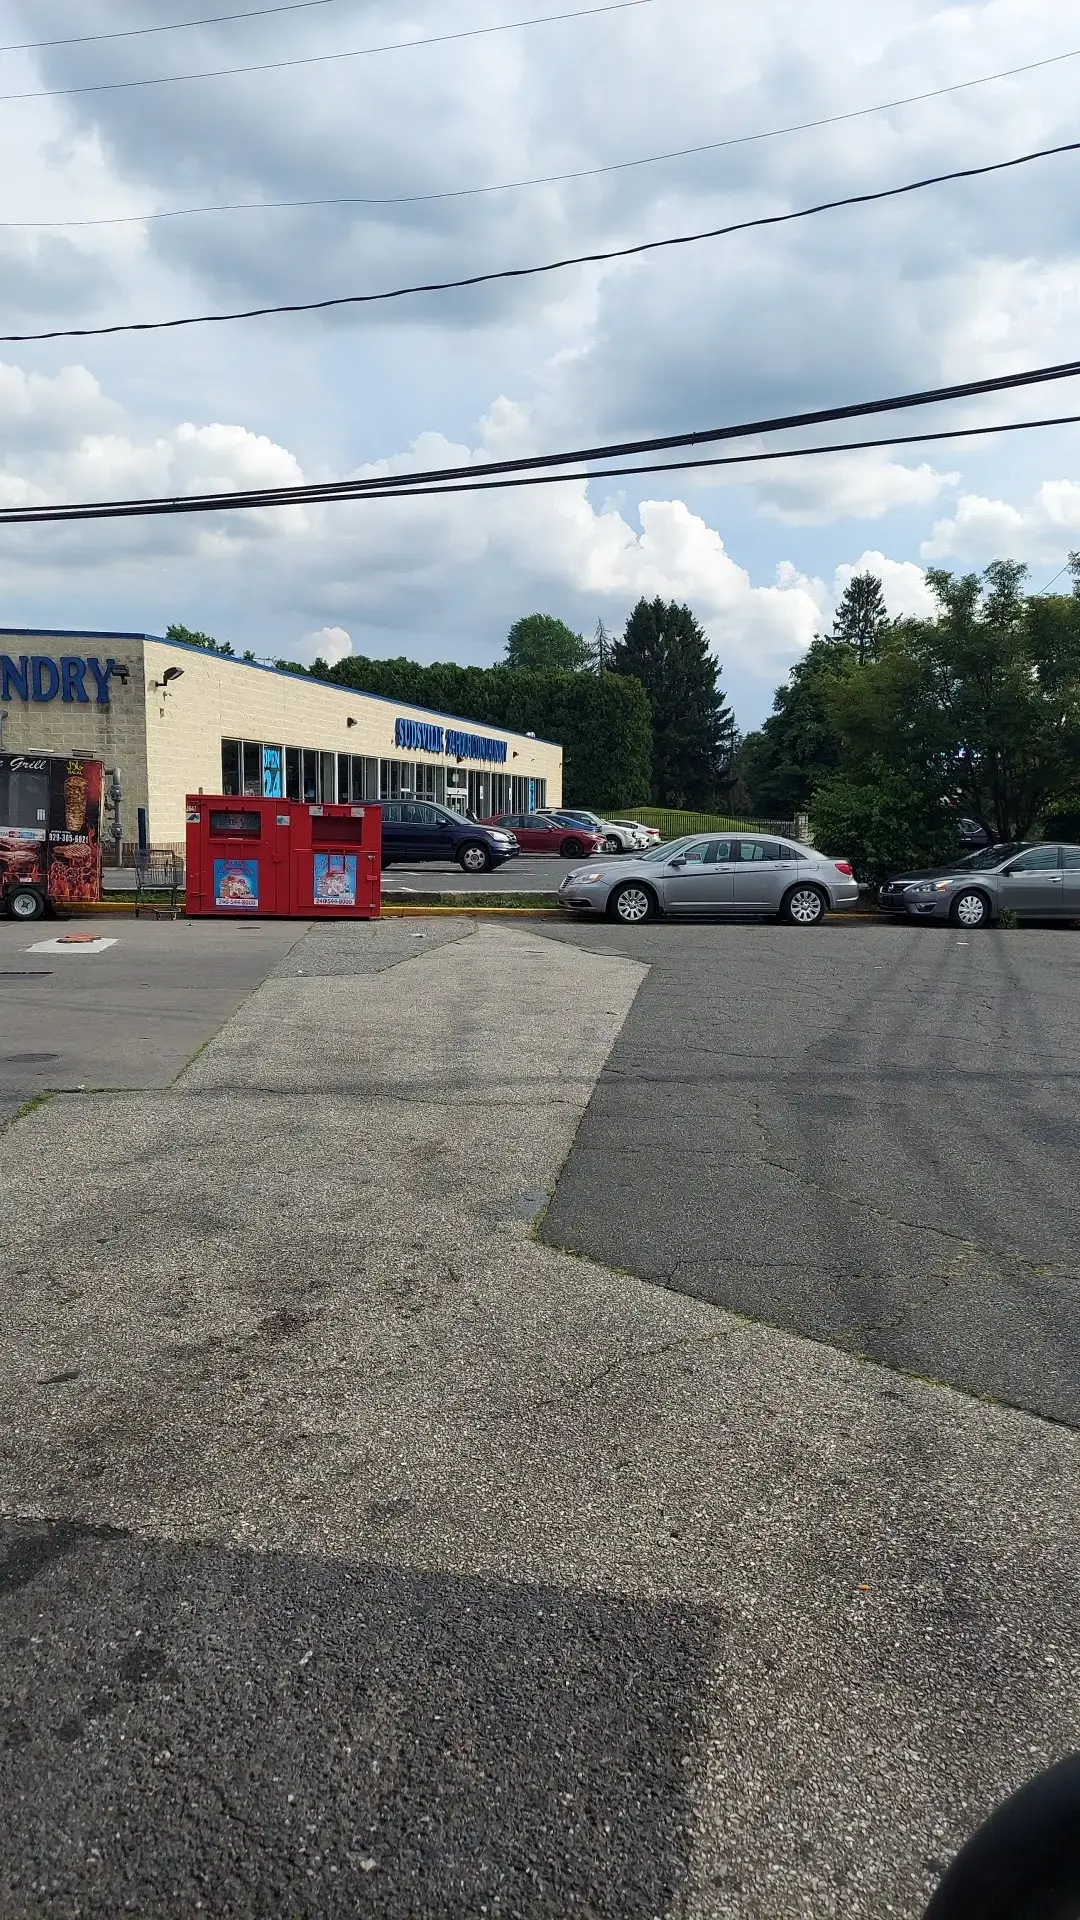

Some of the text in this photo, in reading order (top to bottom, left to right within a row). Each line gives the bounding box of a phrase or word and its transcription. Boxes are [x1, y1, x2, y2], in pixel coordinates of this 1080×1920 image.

[0, 655, 115, 703] NDRY
[395, 718, 444, 755] SUDSVILLE
[10, 757, 47, 771] Grill
